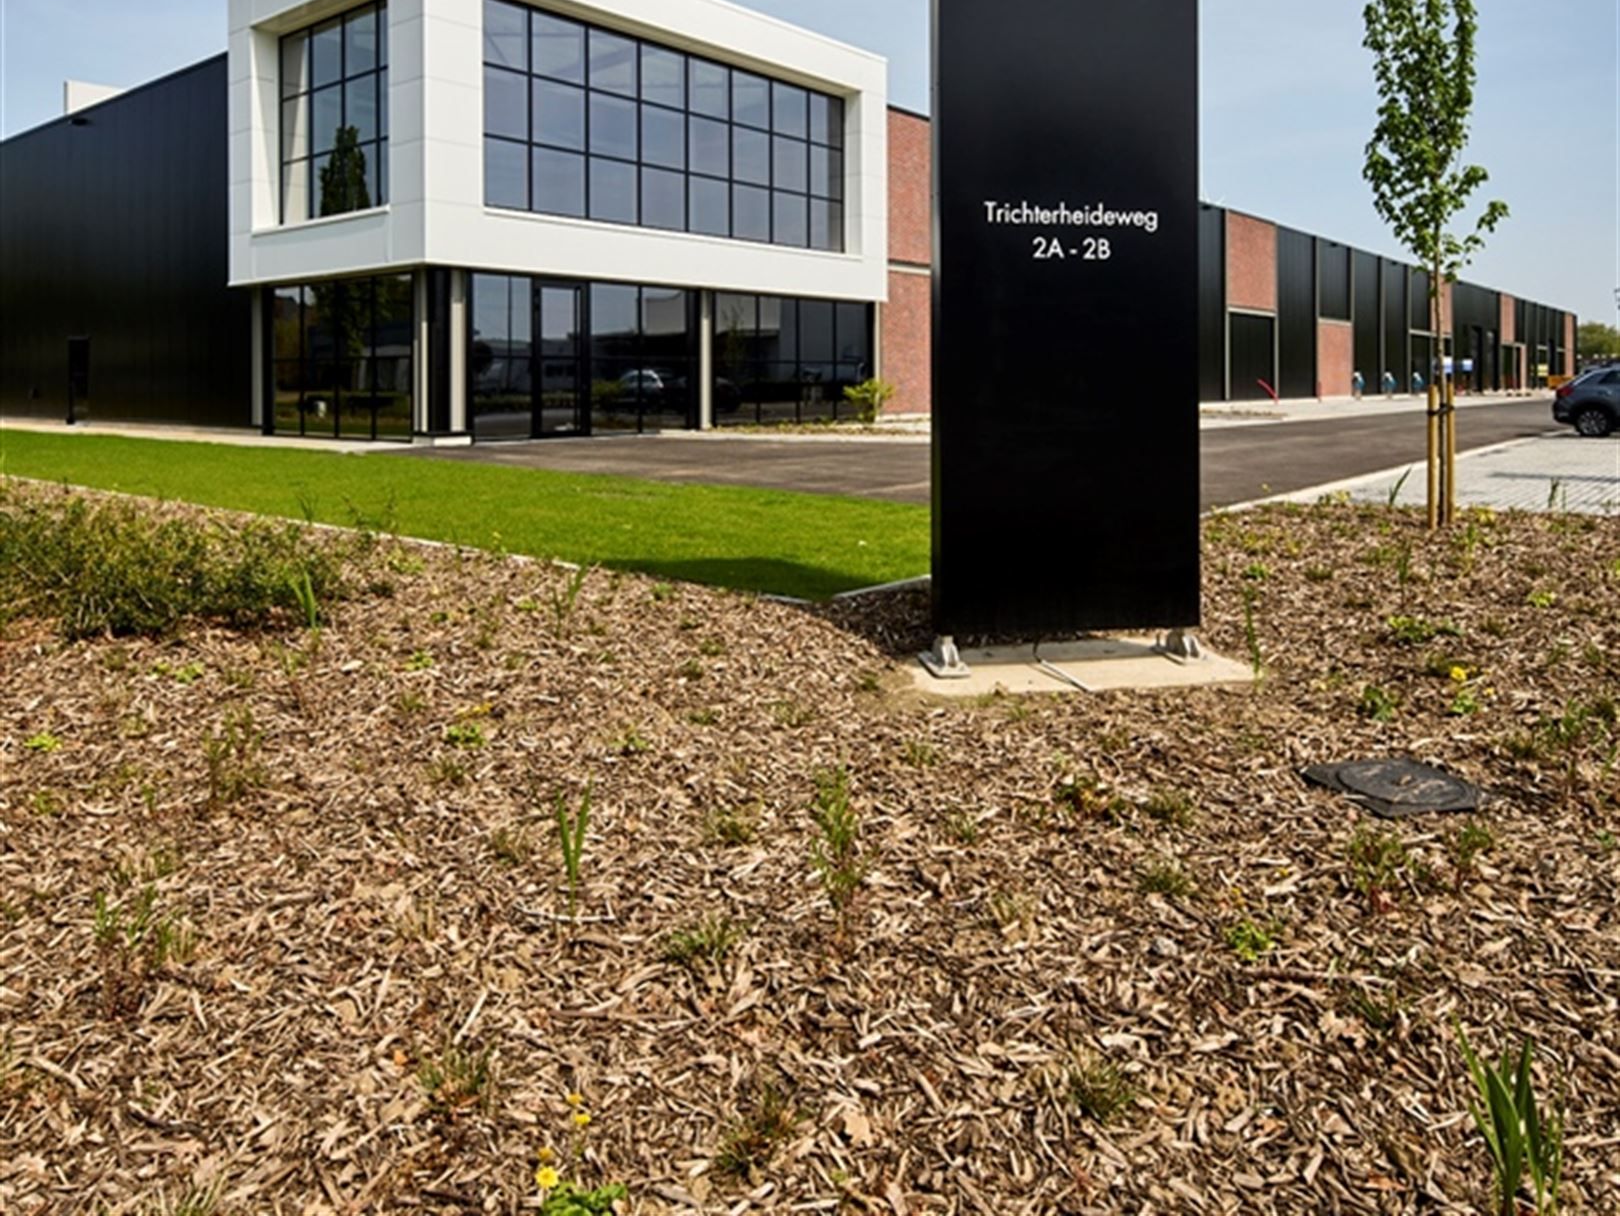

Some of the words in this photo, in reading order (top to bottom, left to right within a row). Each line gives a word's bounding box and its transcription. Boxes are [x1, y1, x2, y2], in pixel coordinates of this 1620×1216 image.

[984, 200, 1159, 233] Trichterheideweg
[1032, 237, 1065, 259] 2A
[1082, 238, 1112, 261] 2B
